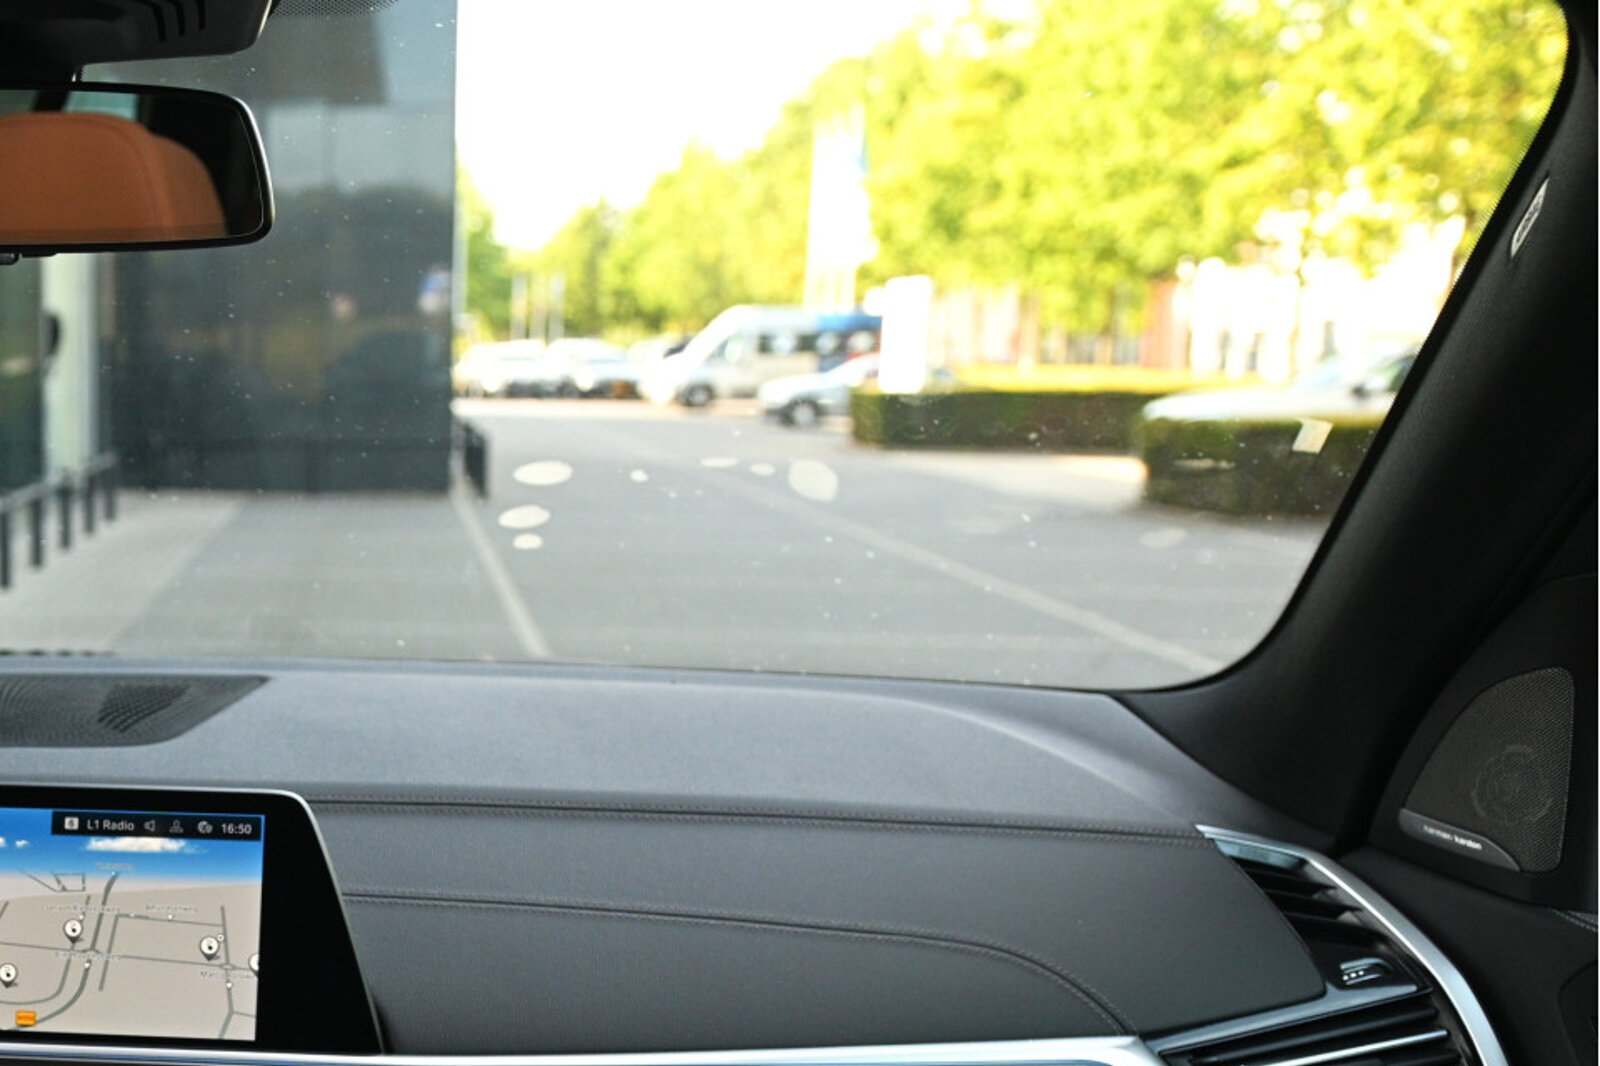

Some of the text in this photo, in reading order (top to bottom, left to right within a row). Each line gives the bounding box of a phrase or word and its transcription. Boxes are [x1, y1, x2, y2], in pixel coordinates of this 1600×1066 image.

[86, 819, 135, 831] L1 Radio
[220, 822, 253, 835] 16:50
